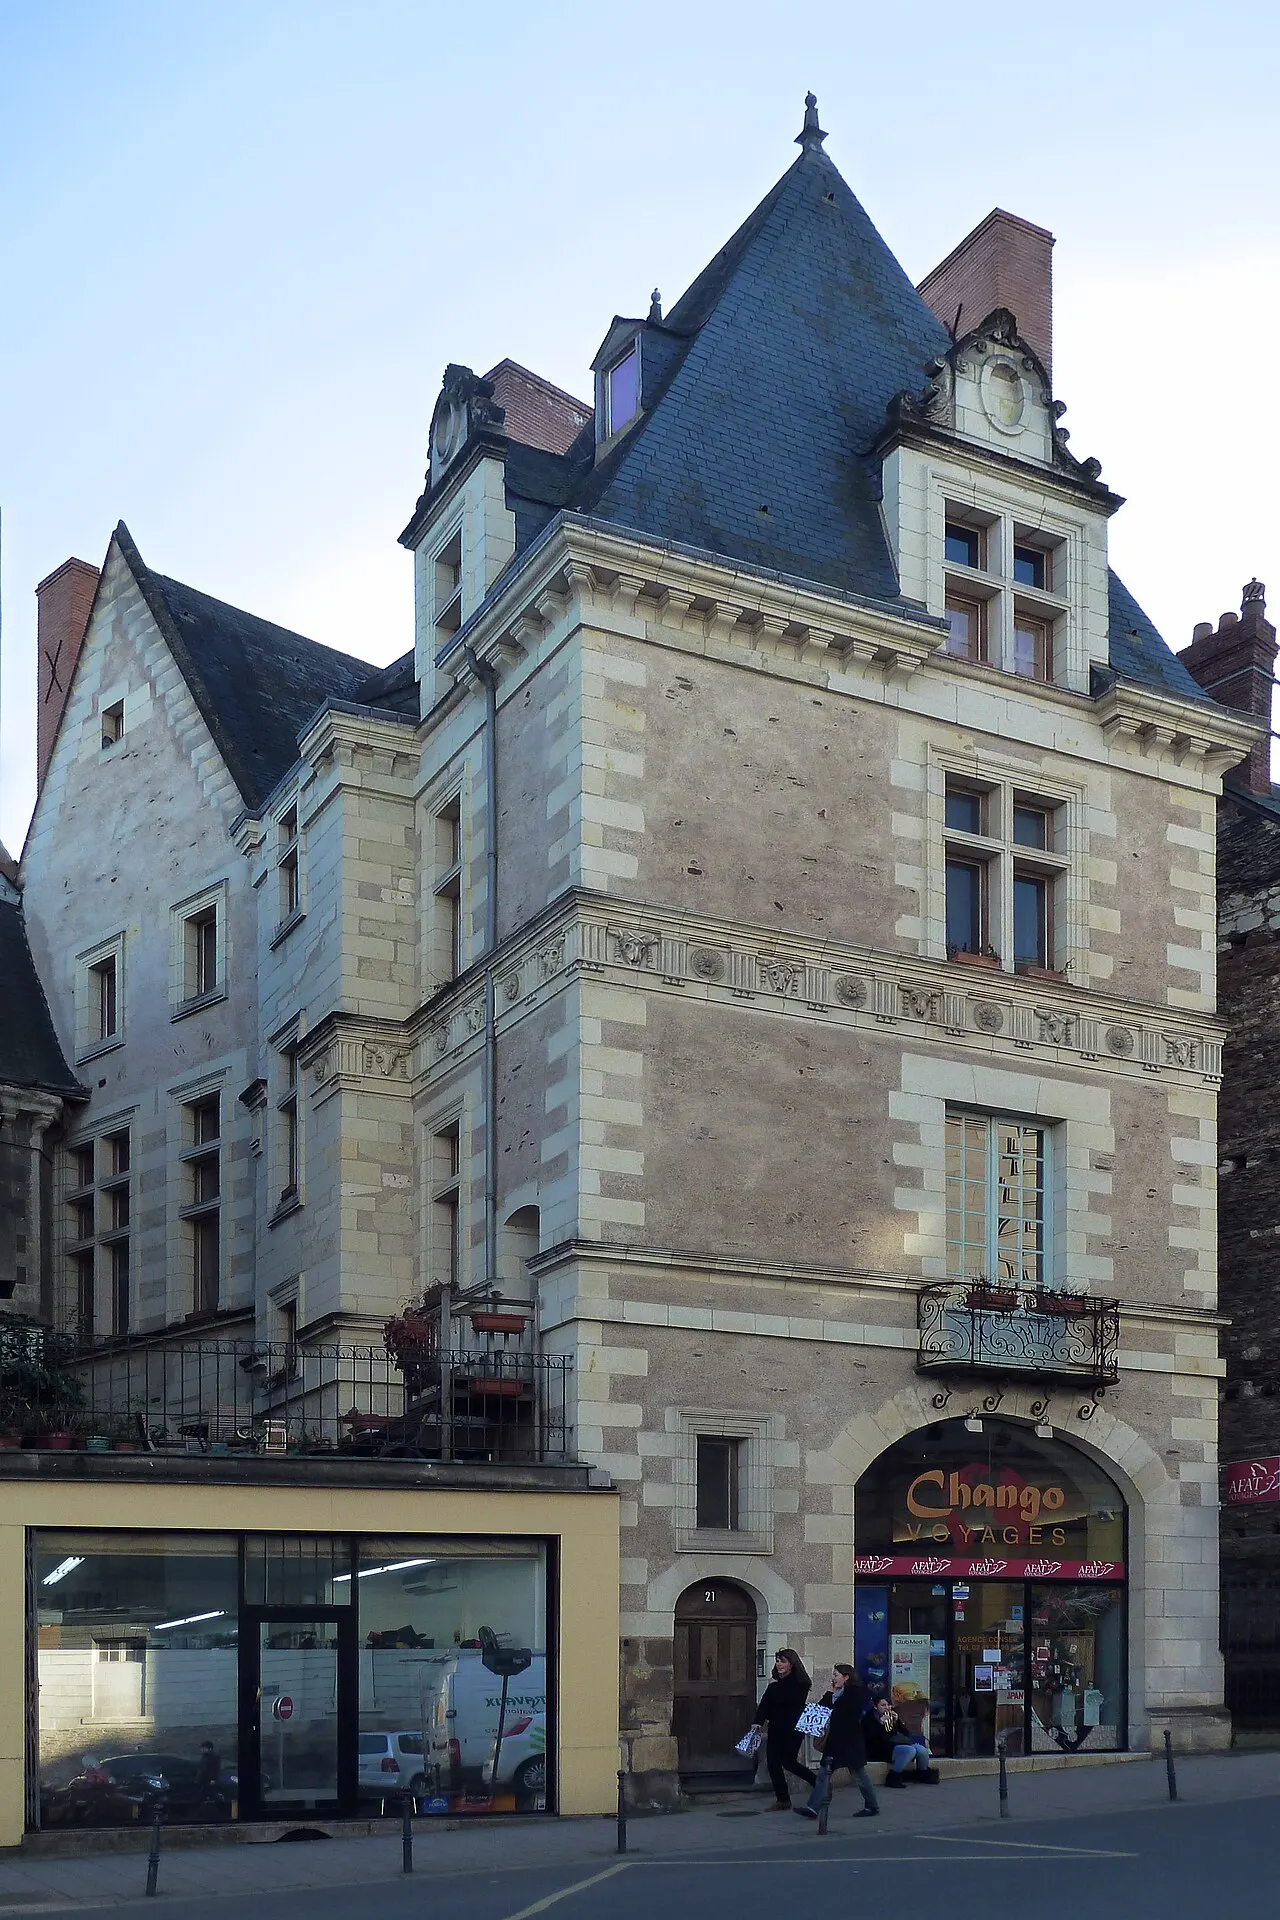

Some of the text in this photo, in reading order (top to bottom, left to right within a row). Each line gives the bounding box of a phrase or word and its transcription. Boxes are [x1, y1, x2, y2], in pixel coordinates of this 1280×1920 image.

[1229, 1477, 1263, 1493] AFAT
[906, 1470, 1065, 1521] Chango
[906, 1523, 1066, 1546] VOYAGES
[854, 1559, 877, 1569] AFAT
[911, 1561, 936, 1570] AFAT
[968, 1563, 992, 1572] AFAT
[1024, 1564, 1047, 1573] AFAT
[1078, 1565, 1101, 1574] AFAT
[705, 1591, 715, 1602] 21
